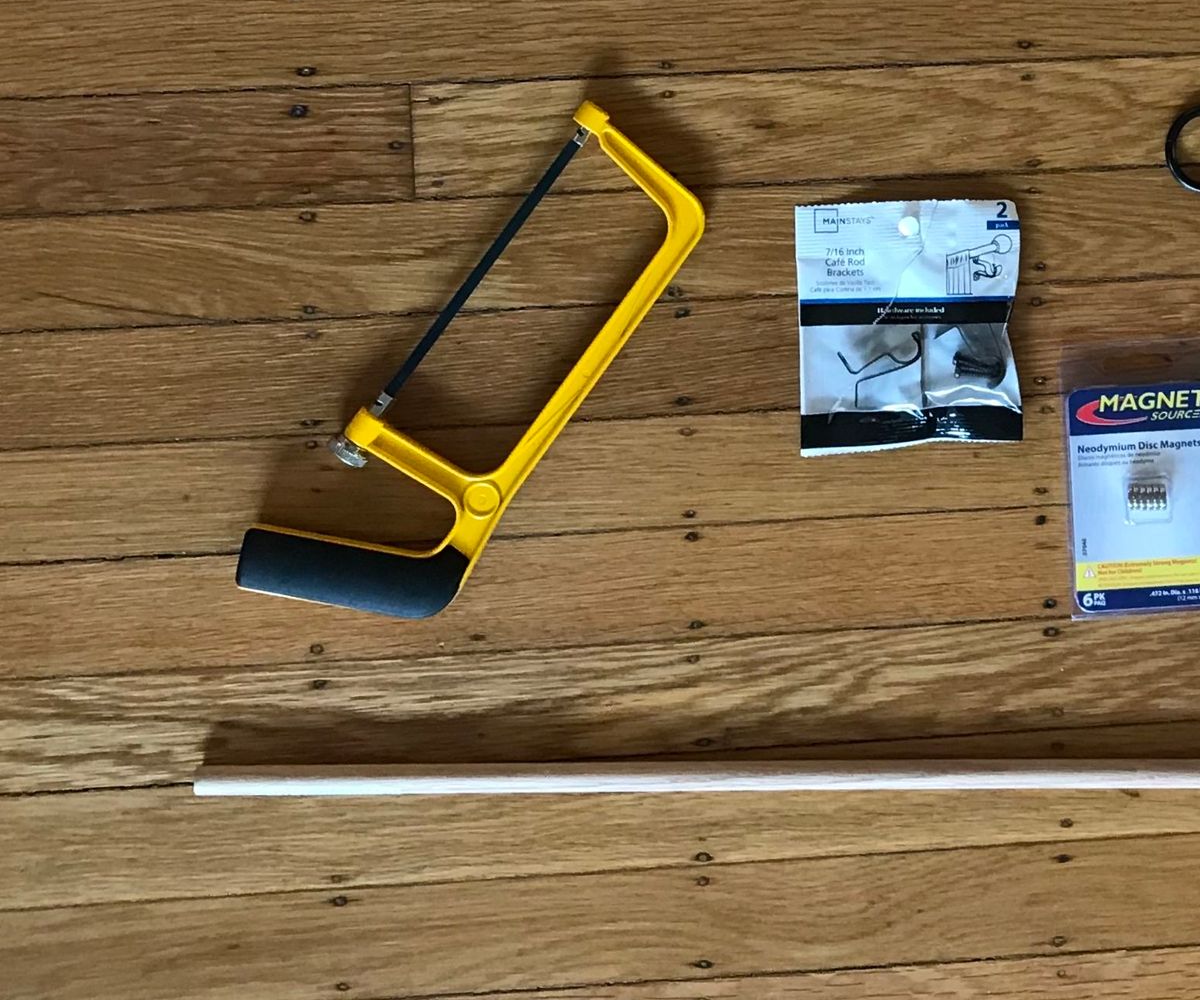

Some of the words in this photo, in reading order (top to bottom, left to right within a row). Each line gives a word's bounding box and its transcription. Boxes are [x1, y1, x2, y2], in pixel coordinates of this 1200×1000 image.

[995, 201, 1008, 219] 2
[822, 216, 872, 225] MAINSTAYS
[825, 247, 845, 257] 7/16
[846, 247, 865, 256] Inch
[825, 257, 846, 267] Café
[847, 257, 866, 267] Rod
[826, 268, 865, 277] Brackets
[1077, 441, 1136, 455] Neodymium
[1138, 440, 1158, 450] Disc
[1082, 592, 1094, 607] 6
[1093, 592, 1105, 601] PK
